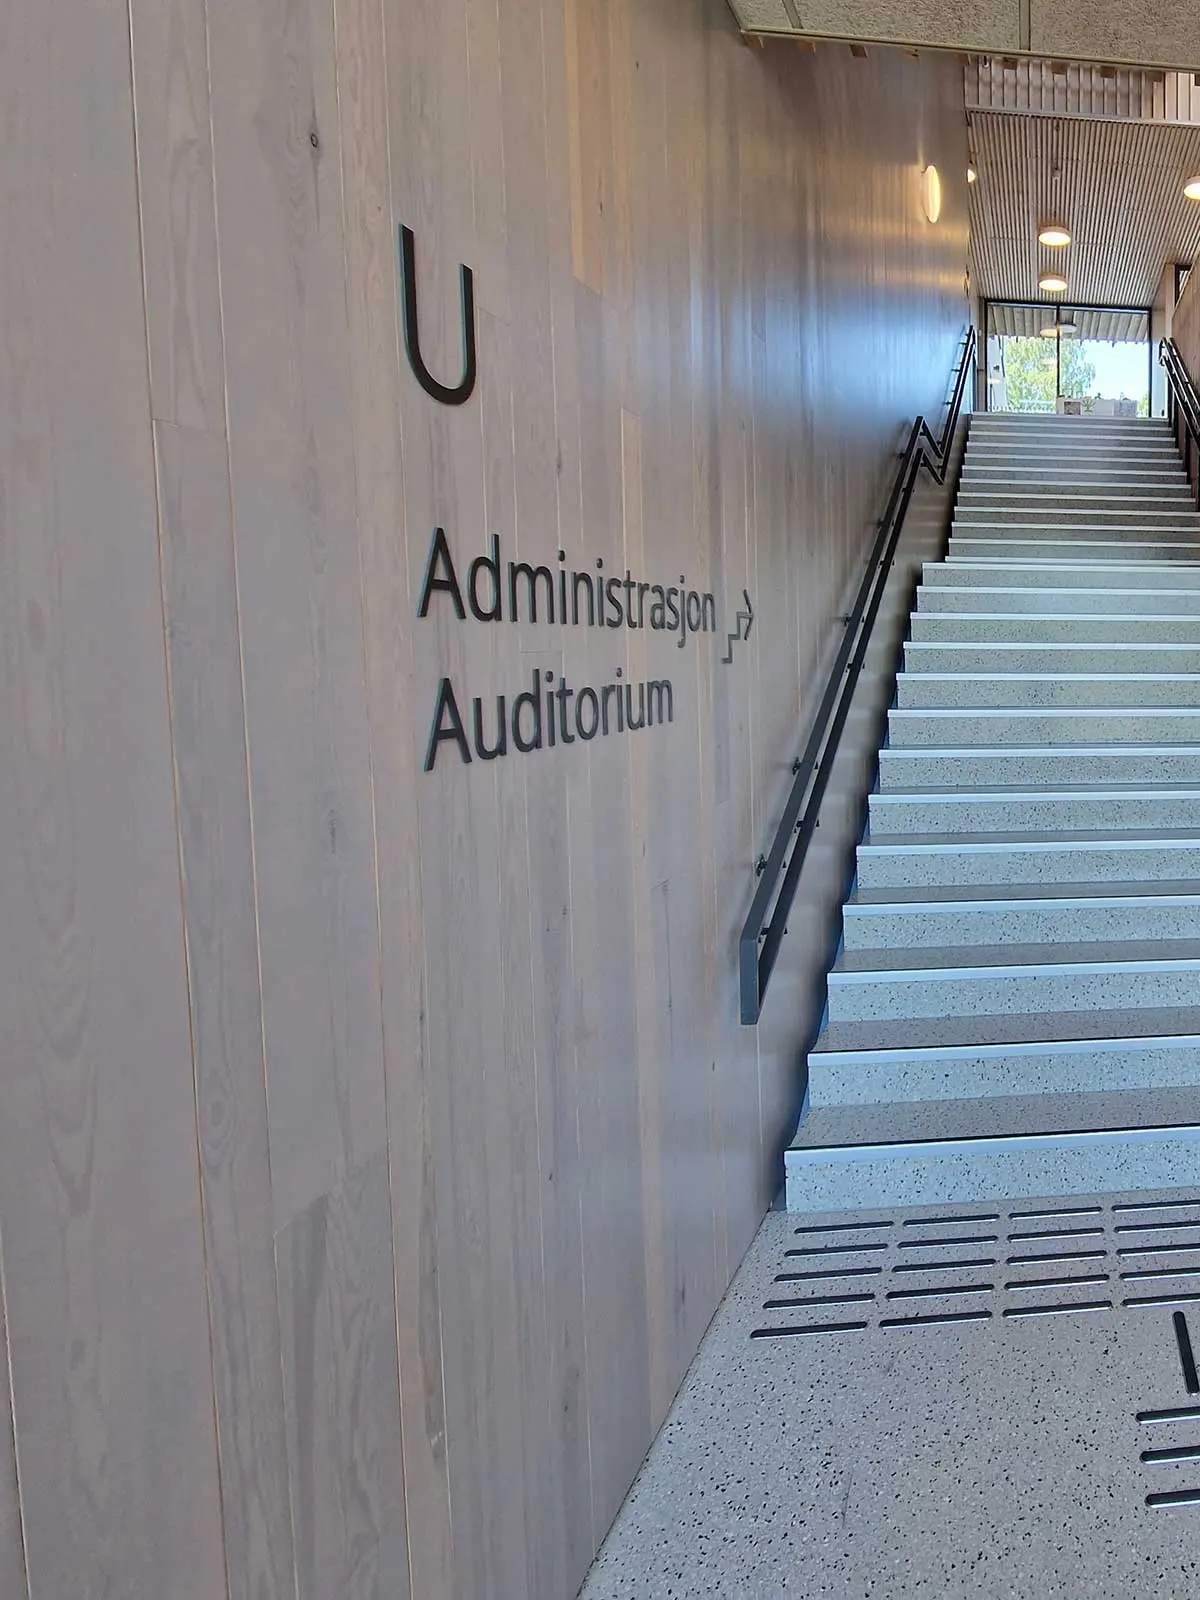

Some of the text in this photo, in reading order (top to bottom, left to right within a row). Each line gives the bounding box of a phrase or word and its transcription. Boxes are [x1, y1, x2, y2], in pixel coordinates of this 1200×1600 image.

[400, 223, 476, 405] U
[417, 527, 716, 648] Administrasjon
[424, 668, 673, 772] Auditorium
